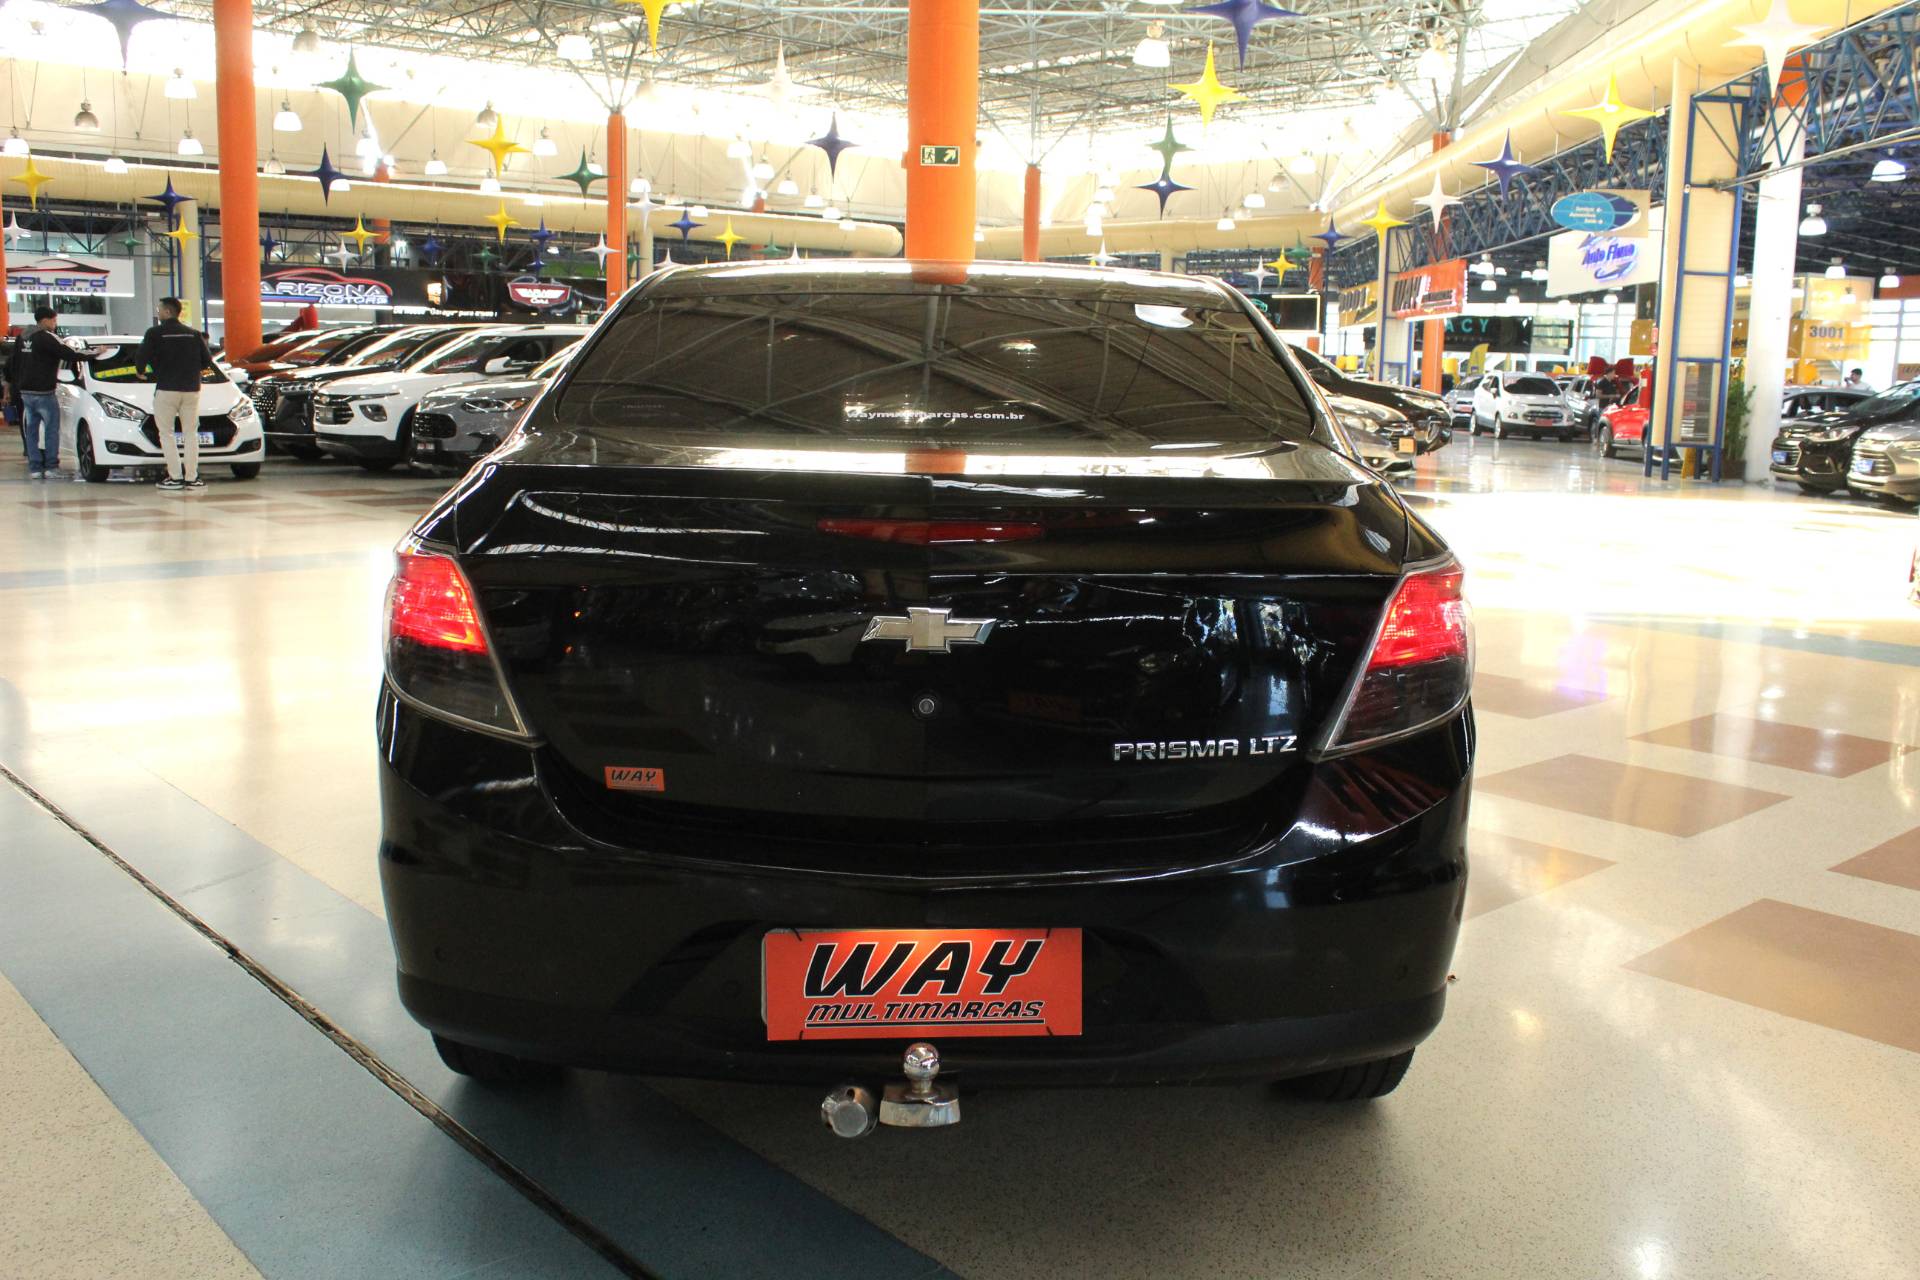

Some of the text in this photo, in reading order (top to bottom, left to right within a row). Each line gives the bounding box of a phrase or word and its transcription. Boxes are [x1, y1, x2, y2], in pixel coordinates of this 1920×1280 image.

[260, 281, 389, 297] ARIZONA
[1809, 325, 1845, 338] 3001
[1113, 734, 1298, 761] PRISMA LTZ
[610, 769, 657, 782] WAY
[803, 939, 1046, 998] WAY
